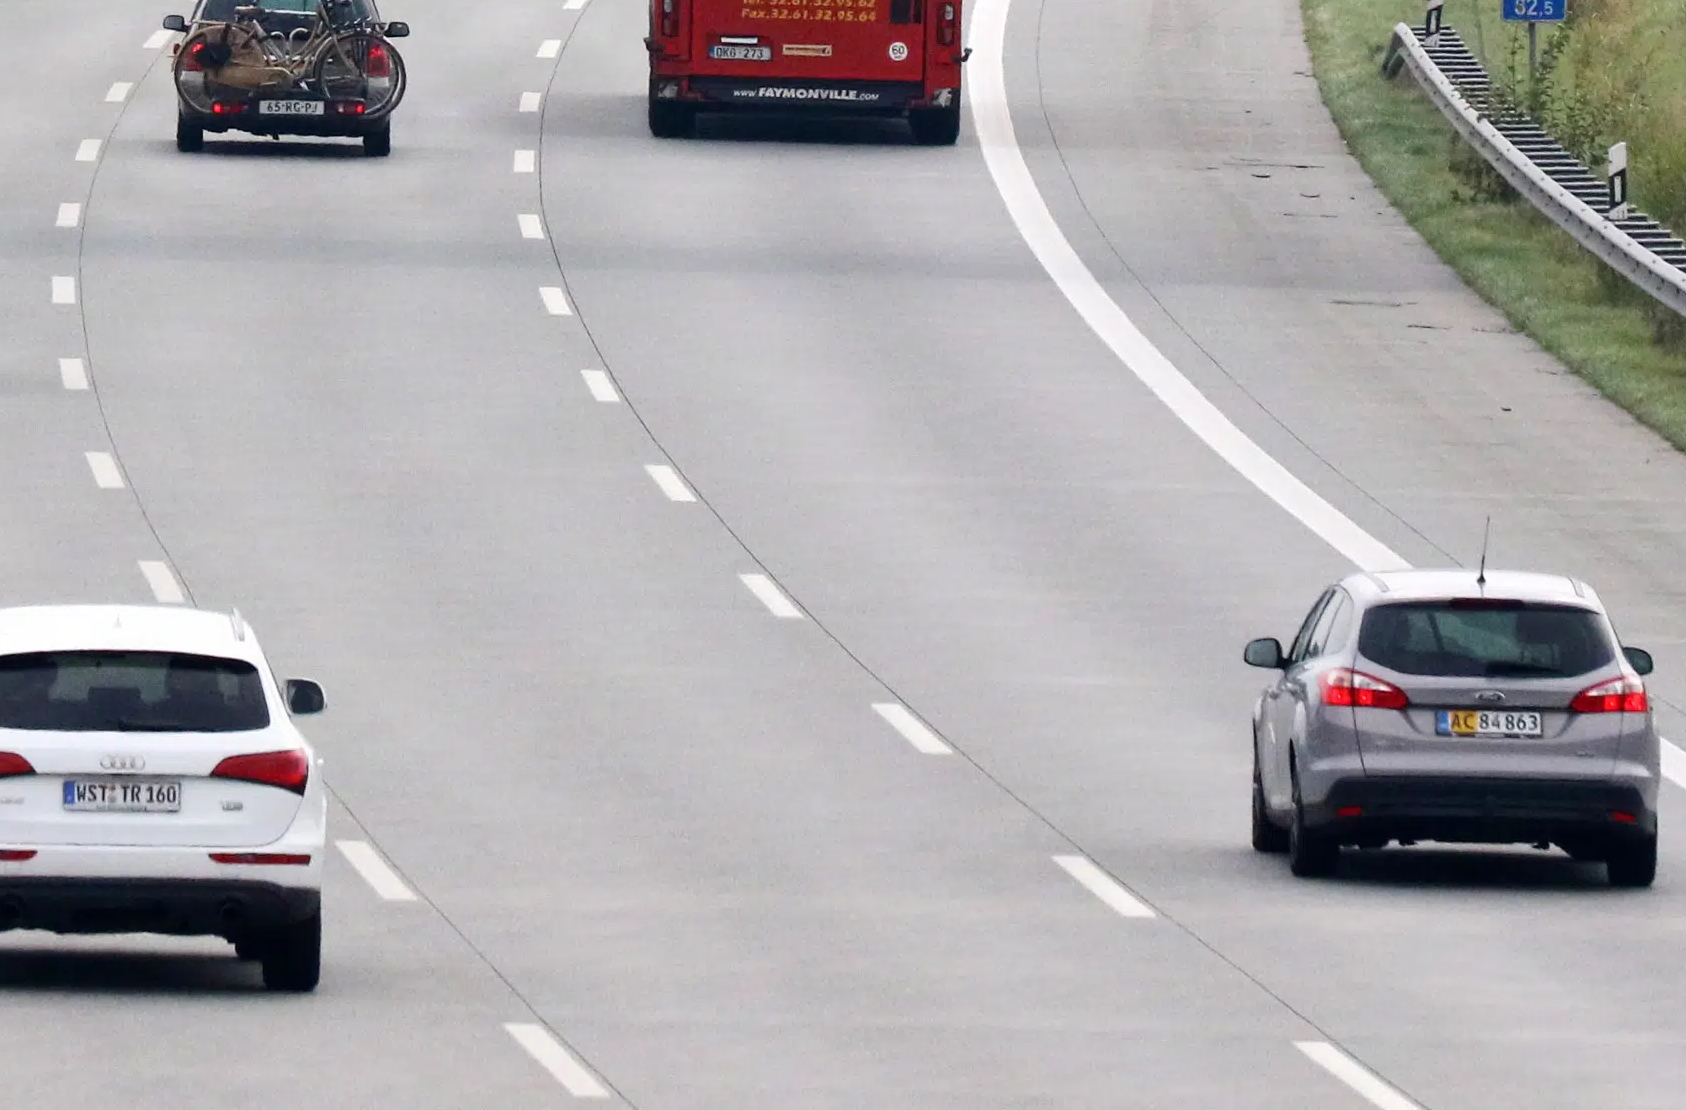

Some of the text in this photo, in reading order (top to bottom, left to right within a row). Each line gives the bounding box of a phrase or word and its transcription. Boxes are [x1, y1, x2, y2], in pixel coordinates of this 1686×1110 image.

[1451, 714, 1475, 730] AC
[77, 786, 177, 804] WST TR 160
